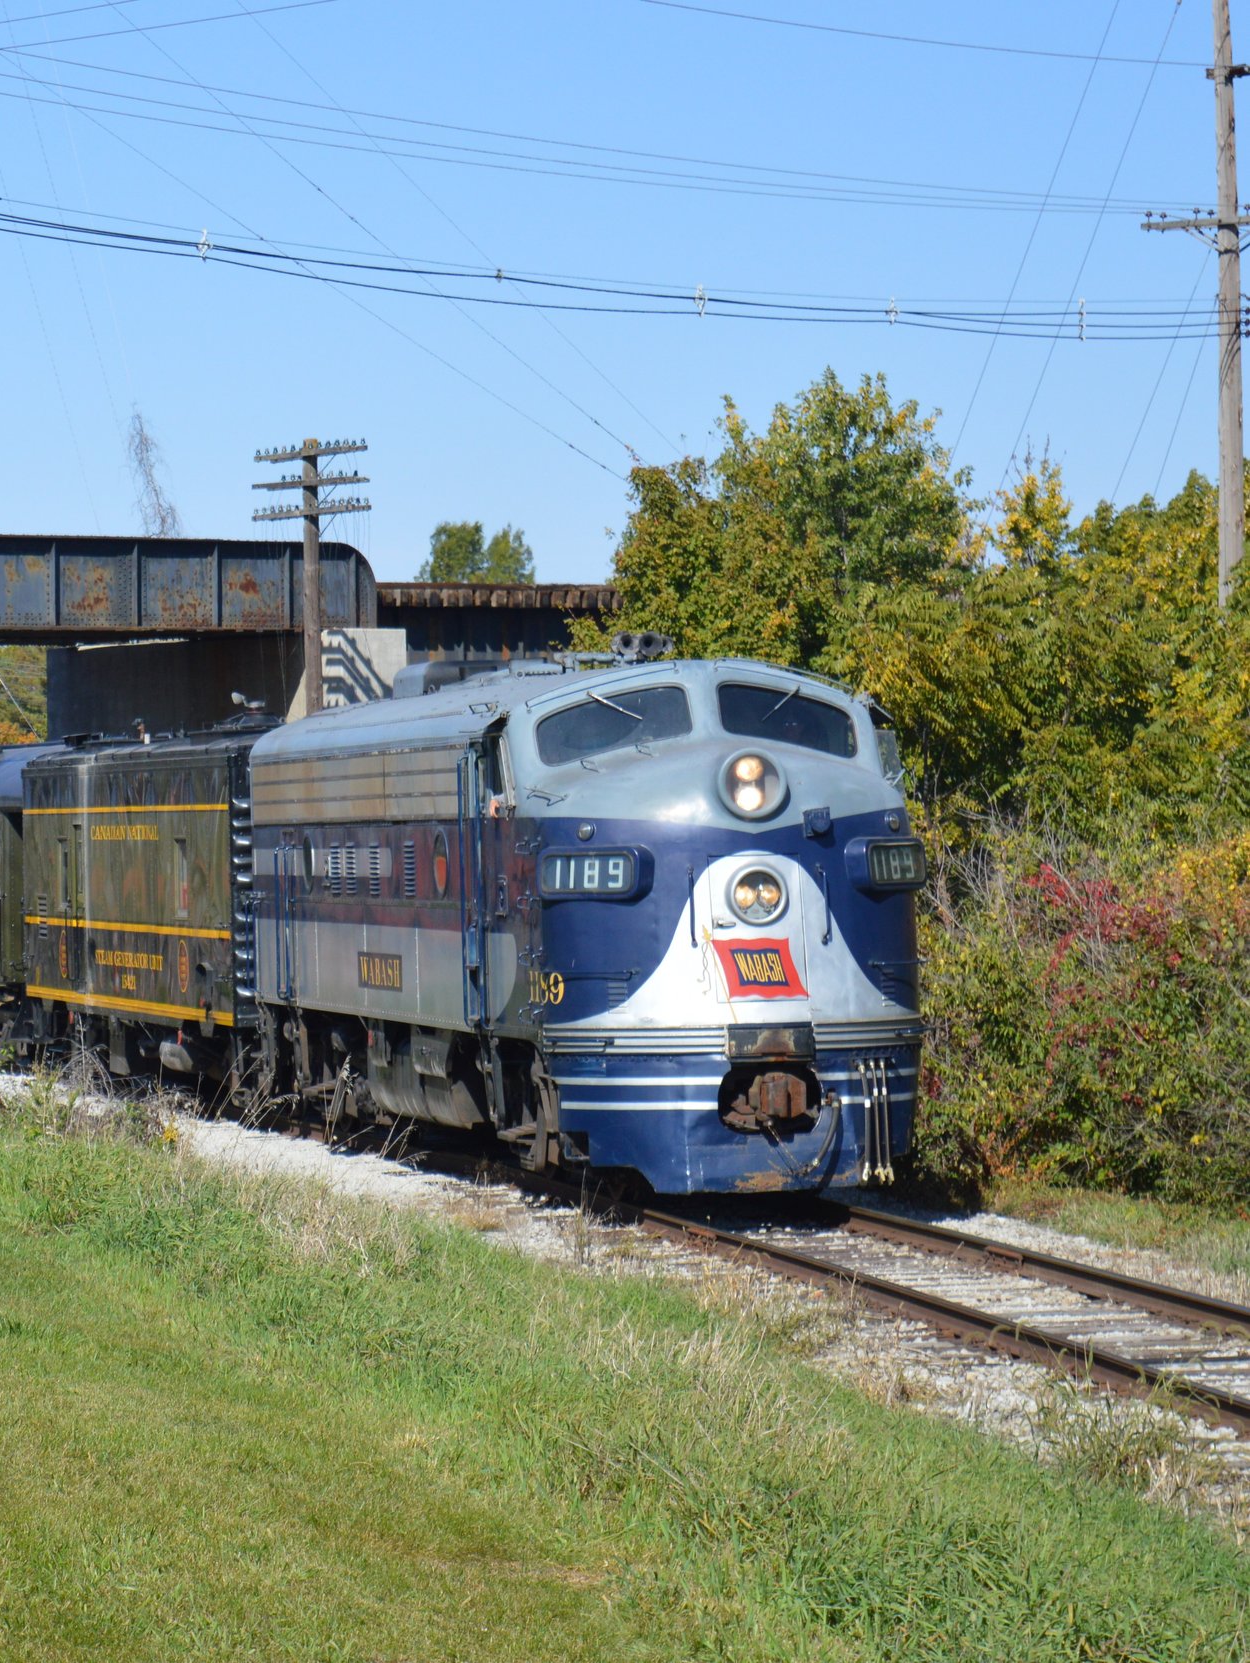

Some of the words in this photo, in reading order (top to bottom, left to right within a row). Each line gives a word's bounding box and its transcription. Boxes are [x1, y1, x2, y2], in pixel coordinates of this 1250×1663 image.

[91, 825, 126, 841] CANADIAN
[127, 825, 158, 841] NATIONAL
[555, 859, 624, 889] 1189
[873, 847, 914, 880] 1189
[114, 951, 149, 969] GENERATOR
[360, 956, 400, 987] WABASH
[734, 953, 785, 982] WABASH
[529, 971, 564, 1004] 1189
